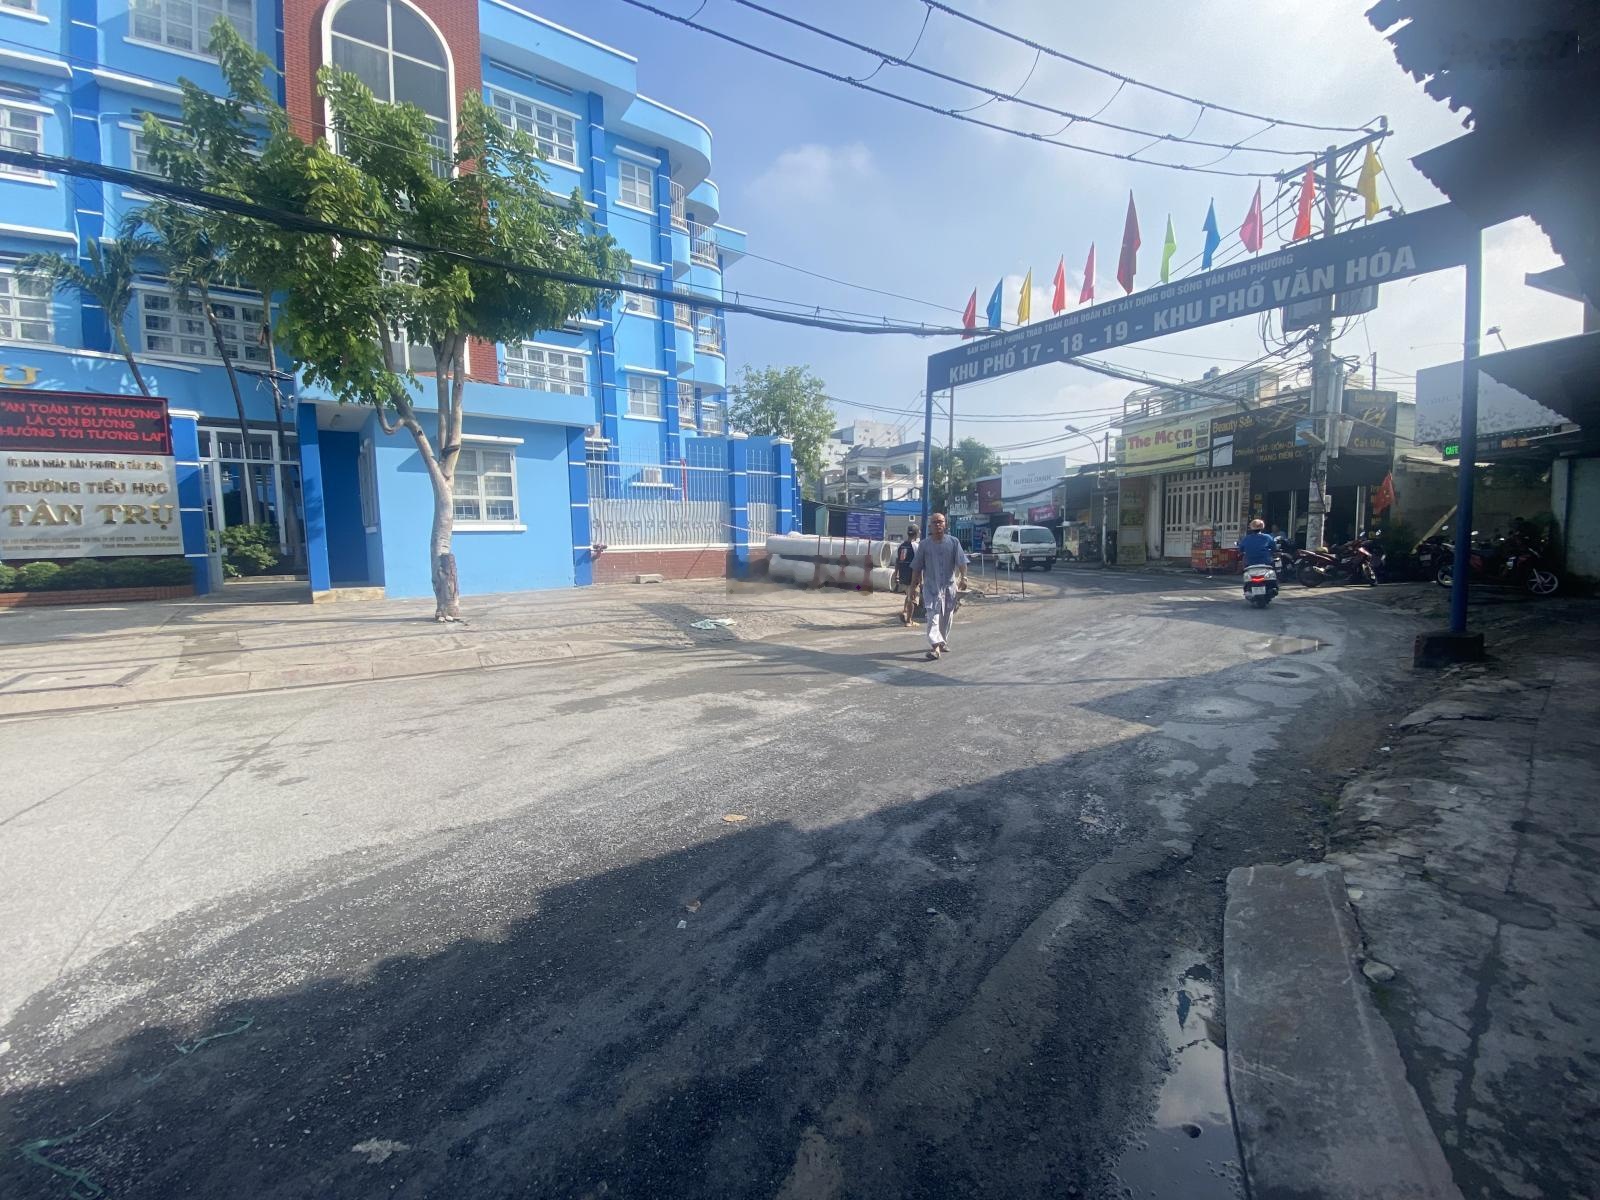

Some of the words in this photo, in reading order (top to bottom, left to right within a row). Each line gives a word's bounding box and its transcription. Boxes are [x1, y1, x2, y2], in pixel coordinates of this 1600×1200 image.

[1118, 299, 1135, 313] XÂY
[1250, 253, 1294, 276] PHƯỜNG
[950, 361, 979, 384] KHU
[983, 344, 1017, 376] PHỐ
[1021, 343, 1042, 365] 17
[1060, 333, 1083, 355] 18
[1103, 320, 1128, 344] 19
[1153, 301, 1201, 332] KHU
[1209, 276, 1267, 319] PHỐ
[1272, 264, 1336, 303] VĂN
[1345, 245, 1417, 285] HÓA
[29, 403, 69, 415] TOÀN
[72, 404, 97, 416] TỚI
[99, 406, 161, 420] TRƯỜNG
[26, 413, 44, 425] LÀ
[47, 416, 79, 427] CON
[82, 417, 136, 430] ĐƯỜNG
[0, 424, 56, 438] HƯỚNG
[59, 427, 84, 438] TỚI
[87, 429, 139, 441] TƯƠNG
[1127, 434, 1152, 450] The
[1176, 440, 1193, 449] KIDS
[4, 478, 81, 494] TRƯỜNG
[86, 477, 127, 494] TIỂU
[132, 481, 169, 497] HỌC
[1, 498, 84, 527] TÂN
[95, 503, 175, 531] TRỤ
